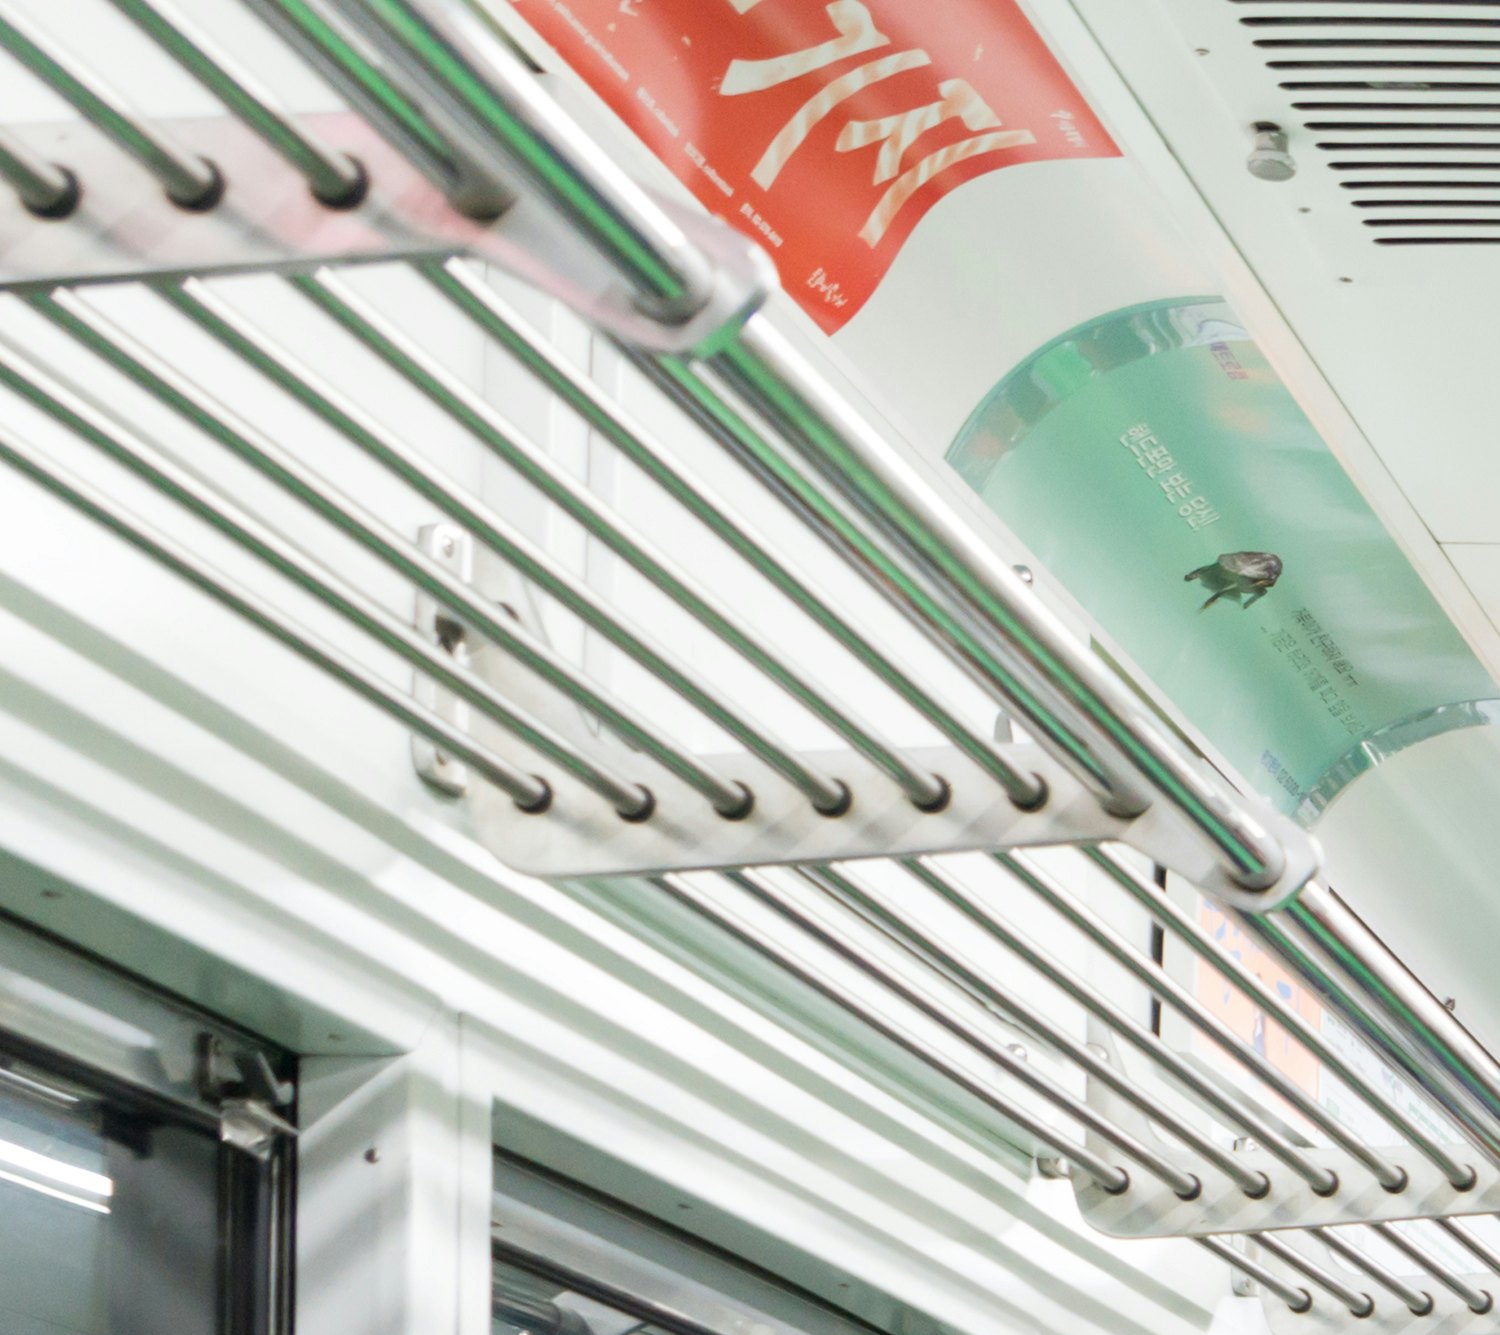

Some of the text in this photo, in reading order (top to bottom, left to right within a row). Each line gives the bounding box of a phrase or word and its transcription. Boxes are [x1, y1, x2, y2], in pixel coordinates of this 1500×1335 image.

[719, 0, 1037, 249] 기지
[1158, 469, 1195, 505] 보는
[1177, 492, 1223, 532] 당신
